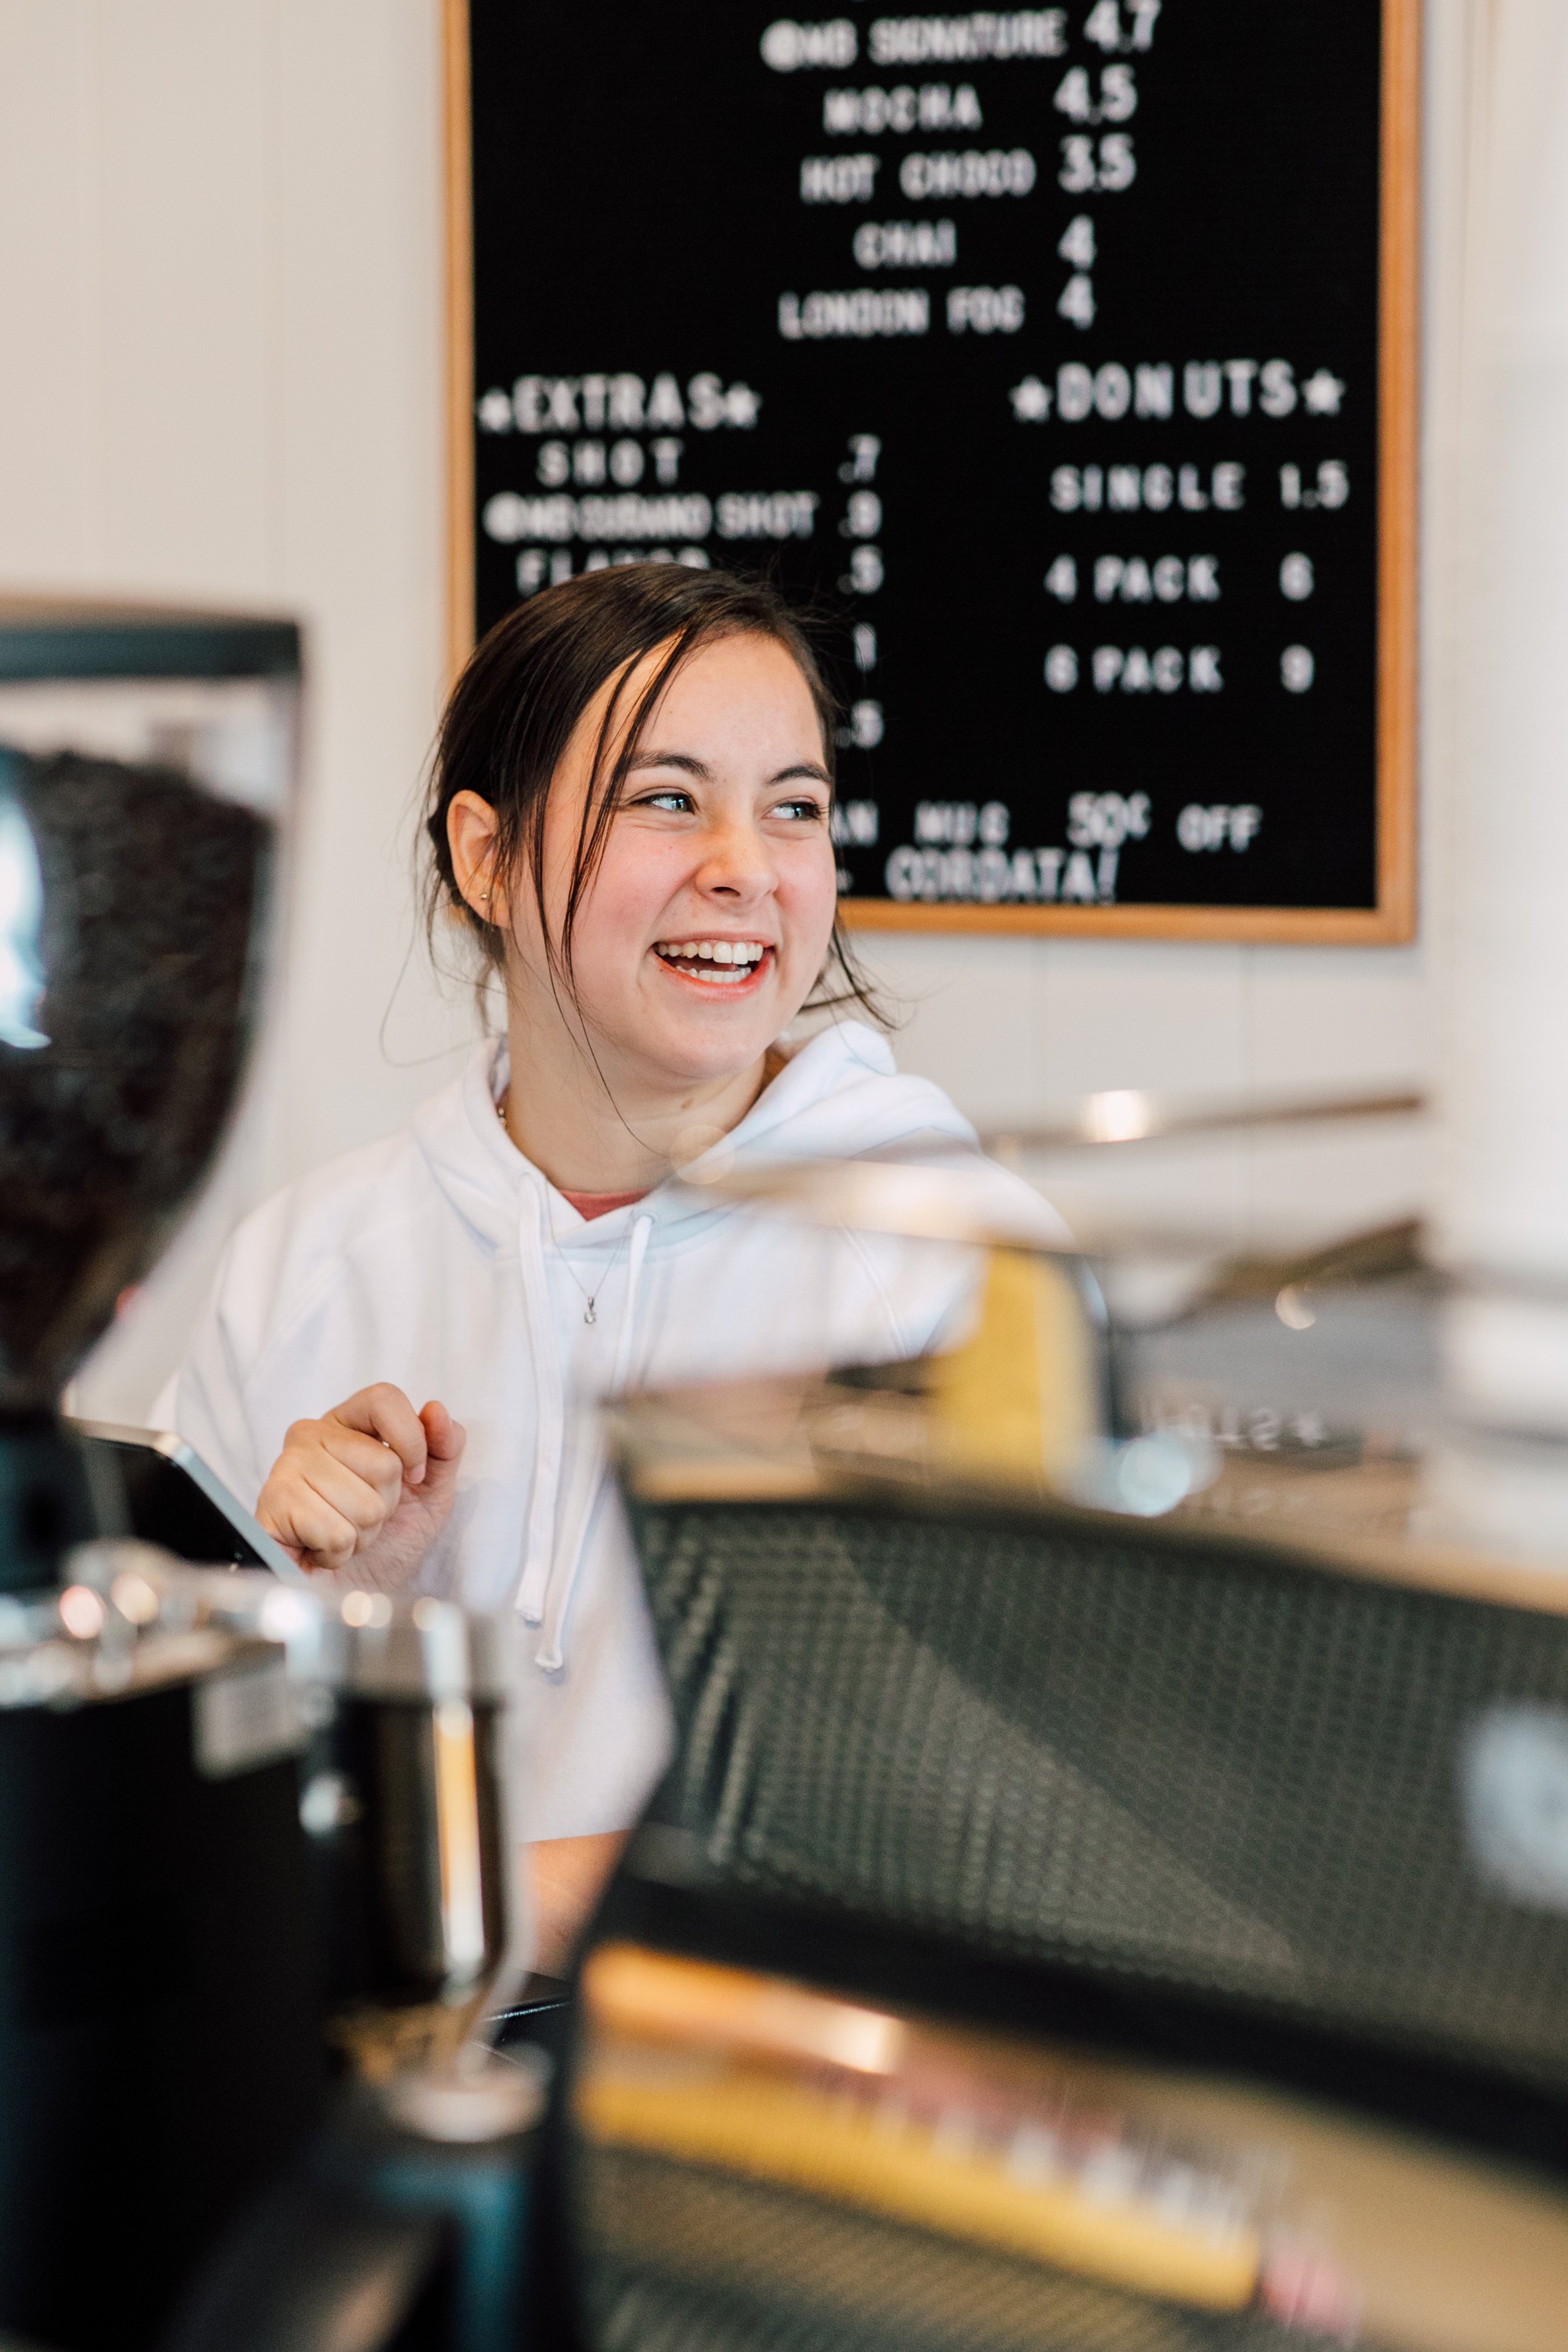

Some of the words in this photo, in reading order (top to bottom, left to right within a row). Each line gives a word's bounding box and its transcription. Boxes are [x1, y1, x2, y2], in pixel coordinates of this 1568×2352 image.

[871, 9, 1067, 65] SIGNATURE
[1085, 0, 1160, 50] 4.7
[824, 86, 981, 132] MOCHA
[1055, 65, 1136, 121] 4.5
[801, 154, 876, 201] HOT
[900, 150, 1036, 198] CHOCO
[1060, 134, 1135, 192] 3.5
[854, 222, 956, 267] CHAI
[1059, 216, 1094, 268] 4
[779, 290, 929, 338] LONDON
[948, 287, 1024, 332] FOG
[1059, 275, 1094, 327] 4
[512, 374, 723, 432] EXTRAS
[1058, 360, 1296, 420] DONUTS
[540, 438, 679, 485] SHOT
[1052, 463, 1242, 511] SINGLE
[1281, 461, 1348, 507] 1.5
[718, 492, 815, 538] SHOT
[1047, 557, 1076, 598] 4
[1095, 556, 1218, 601] PACK
[1281, 553, 1312, 599] 6
[1046, 646, 1076, 691] 6
[1093, 647, 1221, 691] PACK
[1282, 646, 1313, 692] 9
[916, 803, 1008, 845] MUG
[1178, 805, 1259, 850] OFF
